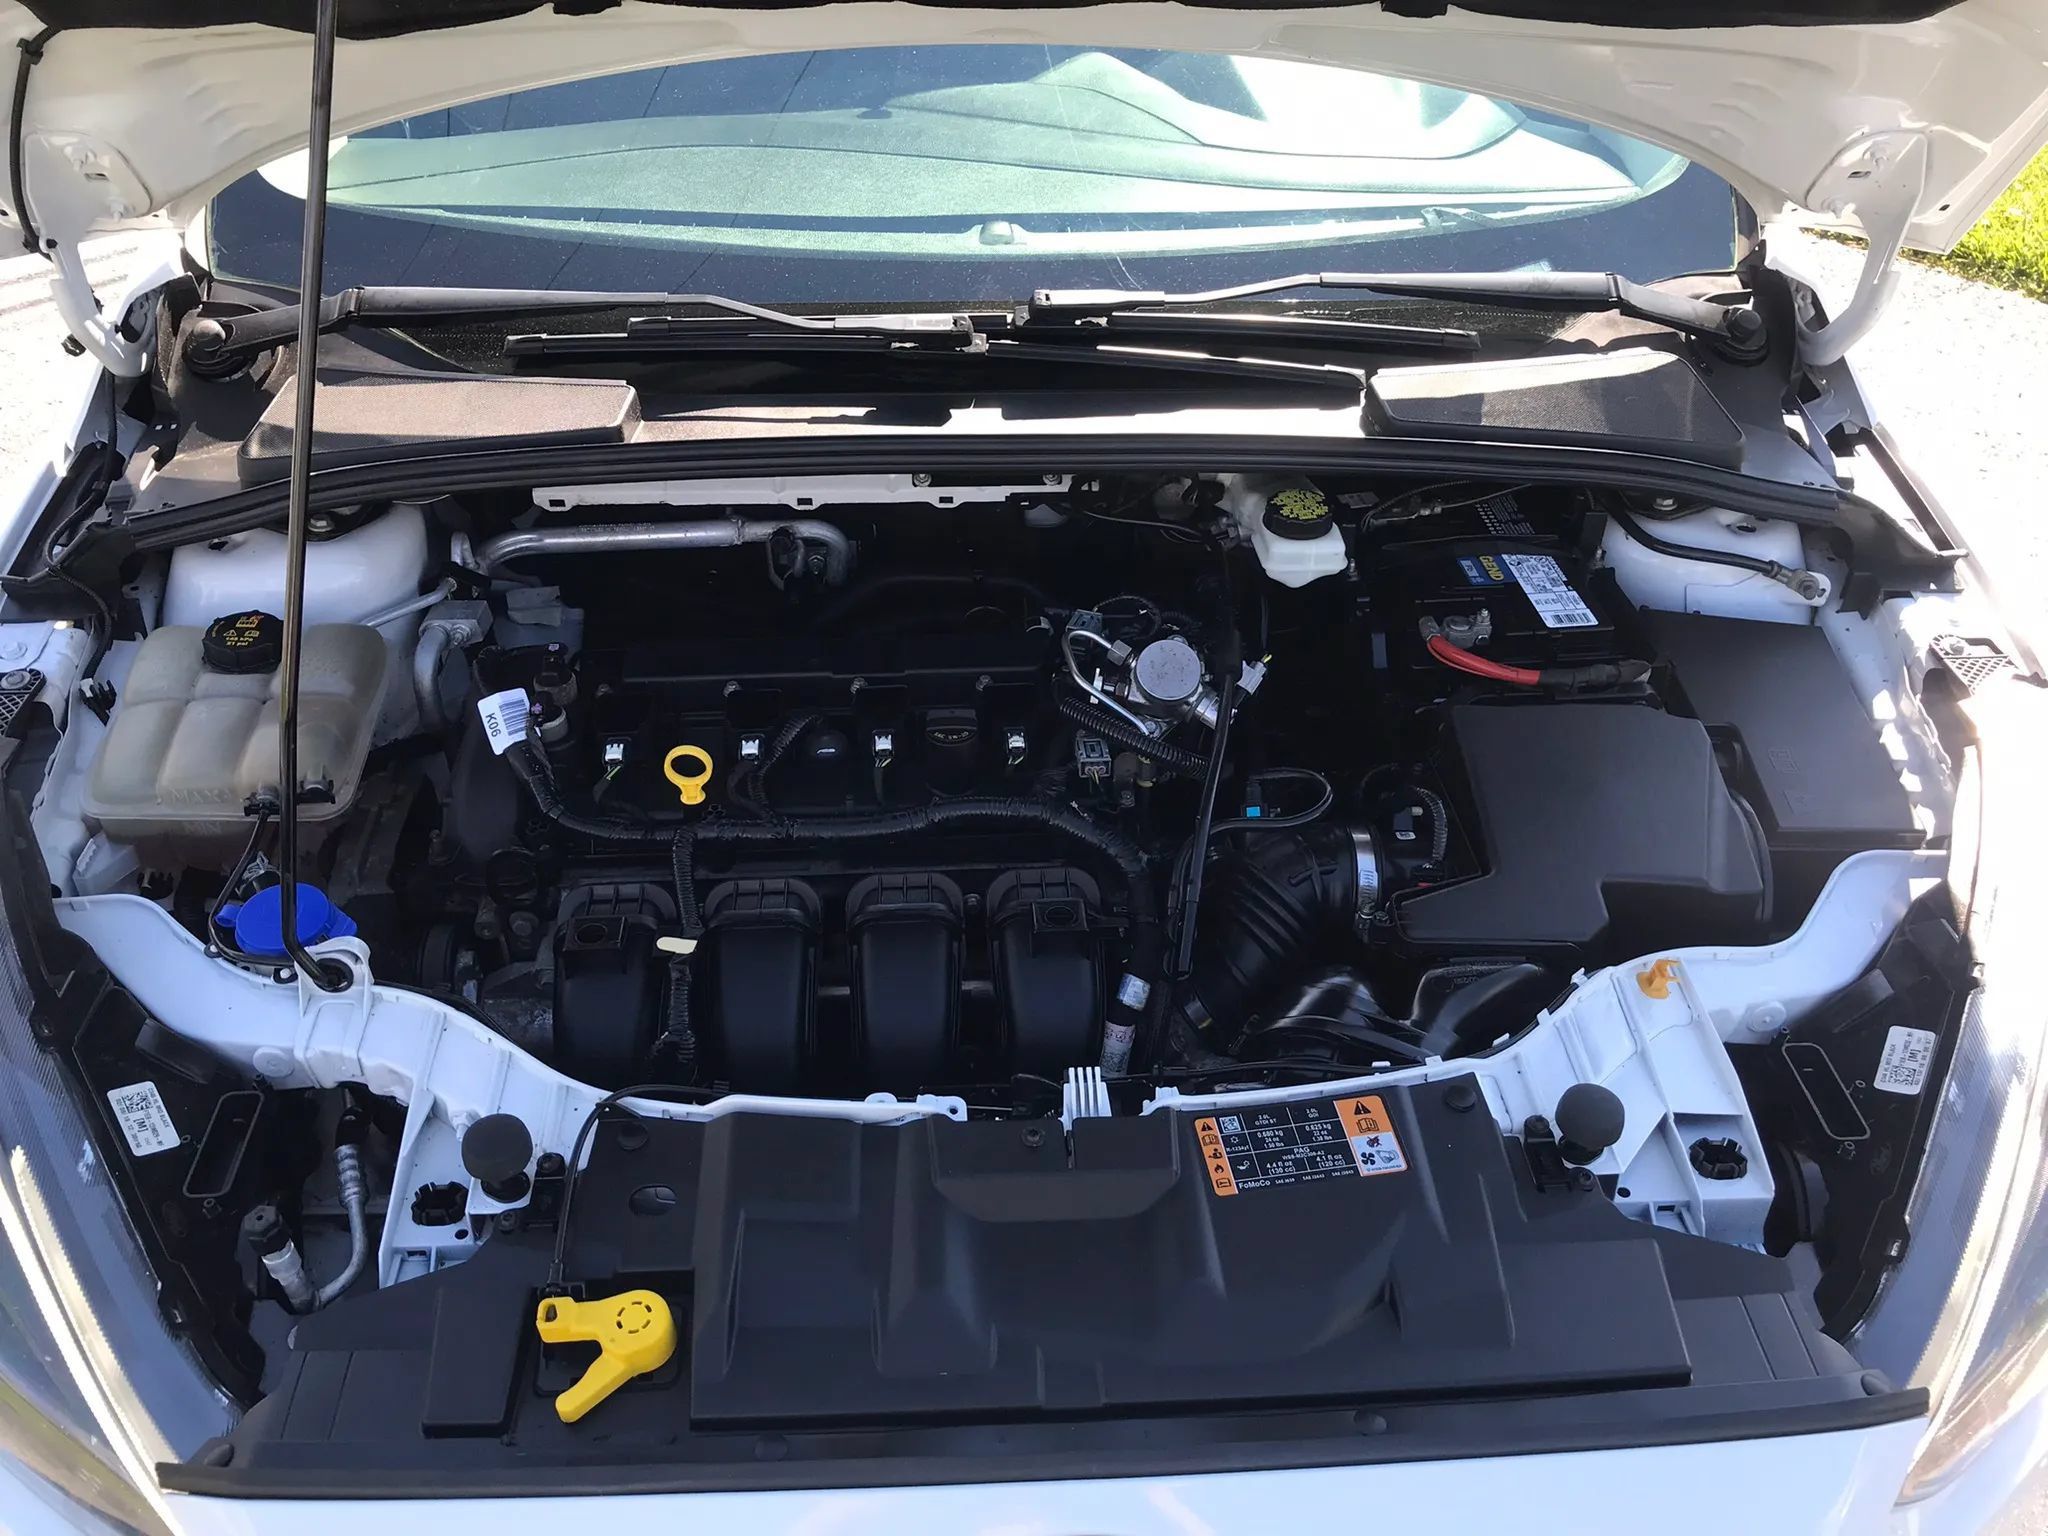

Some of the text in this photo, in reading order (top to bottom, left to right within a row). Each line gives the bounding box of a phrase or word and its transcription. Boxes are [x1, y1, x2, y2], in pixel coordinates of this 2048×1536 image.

[485, 712, 502, 738] K06
[132, 1115, 149, 1134] [M]
[1239, 1179, 1270, 1189] FoMoCo
